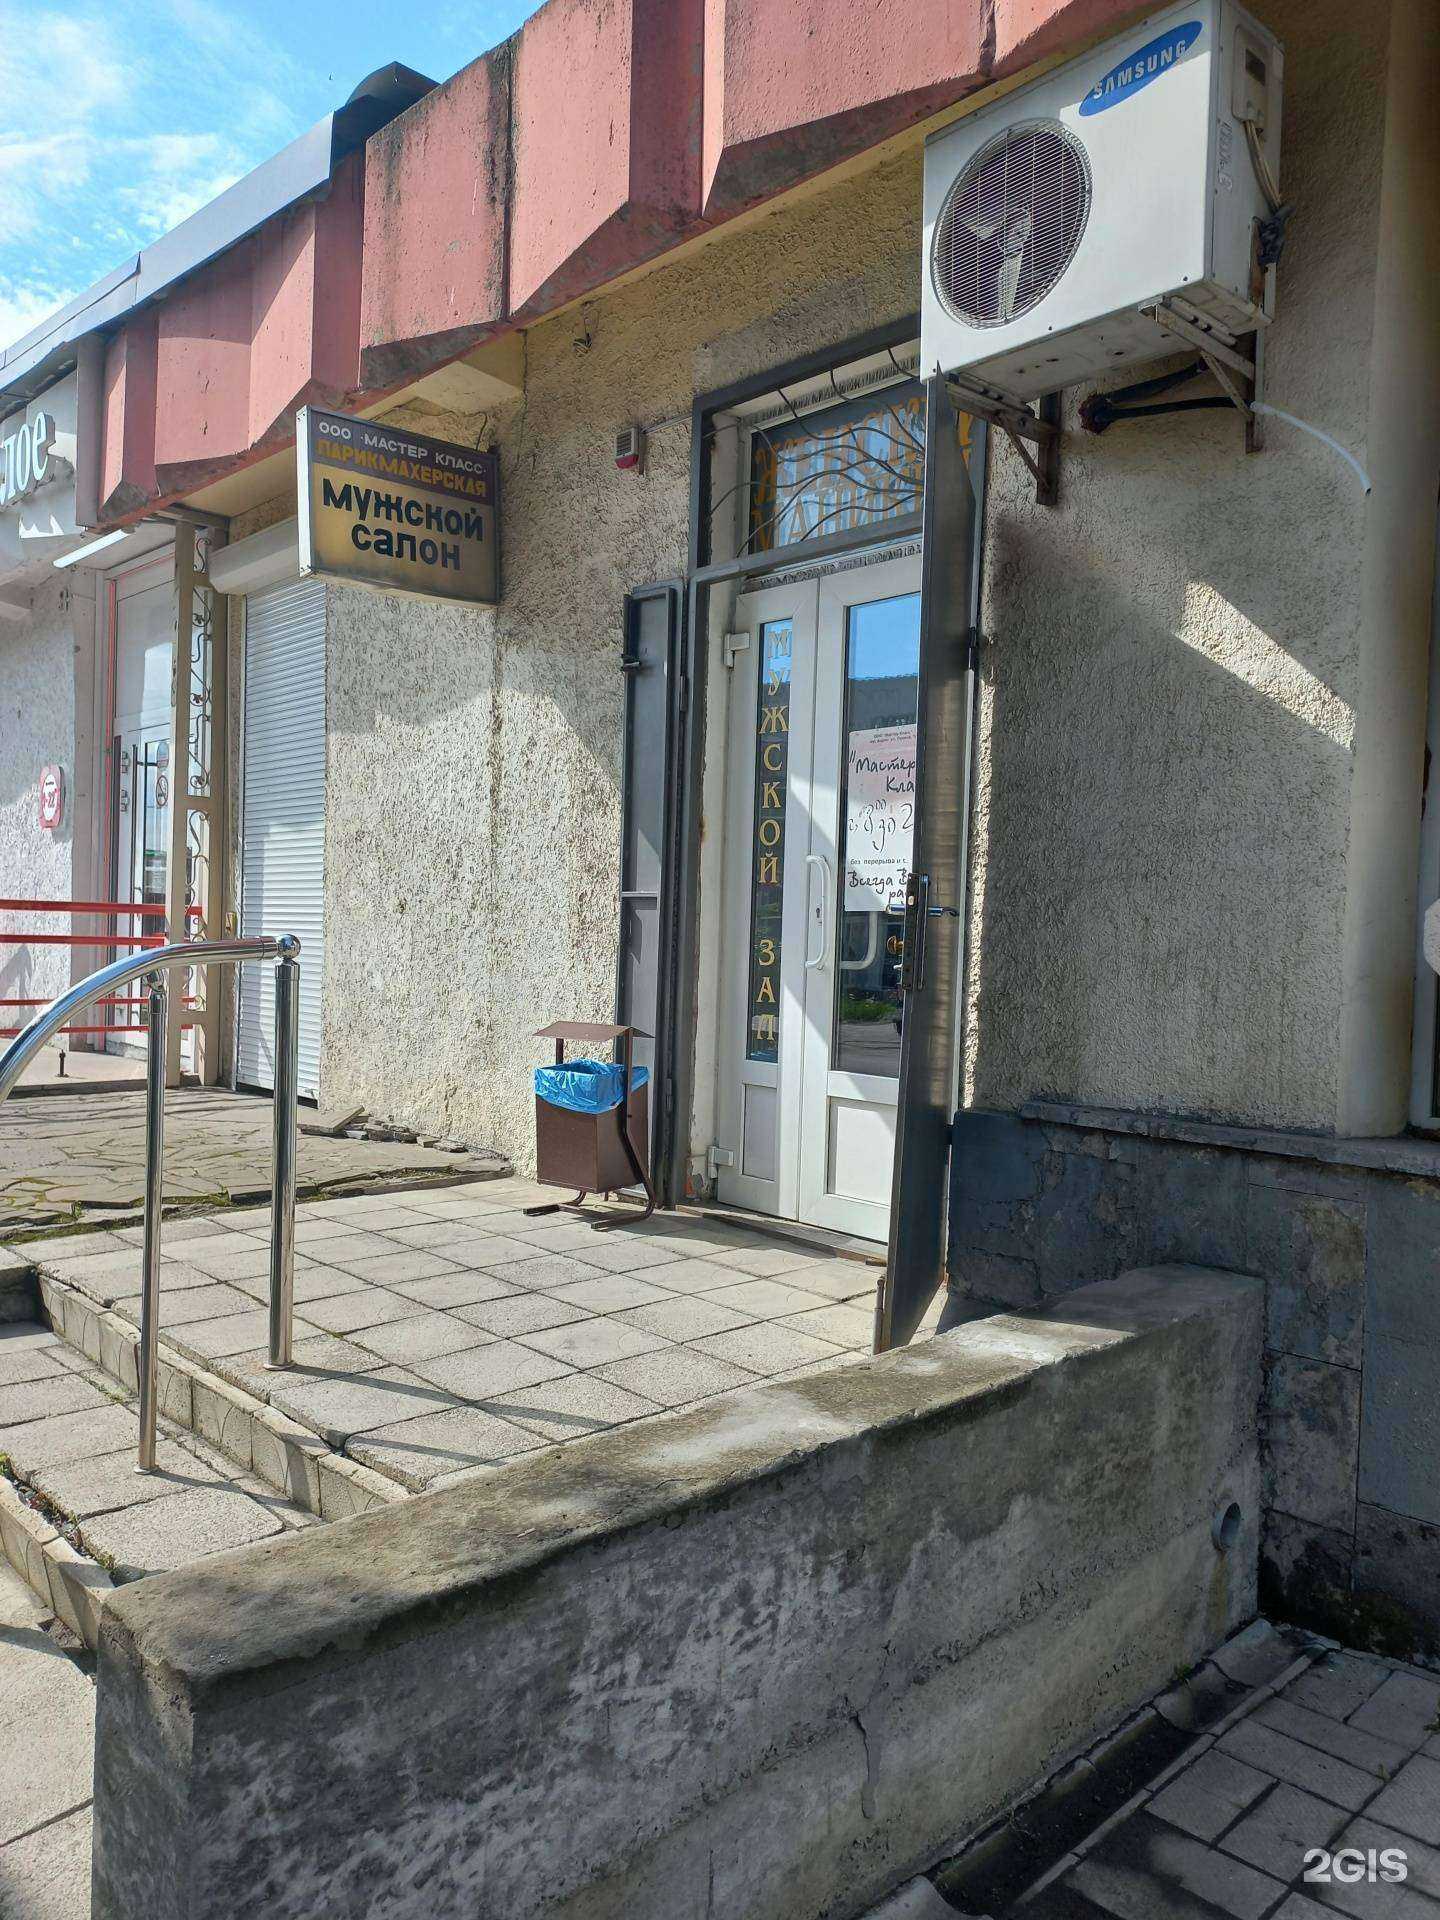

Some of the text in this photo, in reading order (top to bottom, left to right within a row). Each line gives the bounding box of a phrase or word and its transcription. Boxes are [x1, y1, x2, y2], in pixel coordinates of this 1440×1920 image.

[1093, 40, 1186, 99] SAMSUNG
[319, 422, 351, 440] ООО
[316, 439, 487, 498] ПАРИКМАХЕРСКАЯ
[351, 523, 461, 571] салон
[847, 870, 893, 894] Всегда
